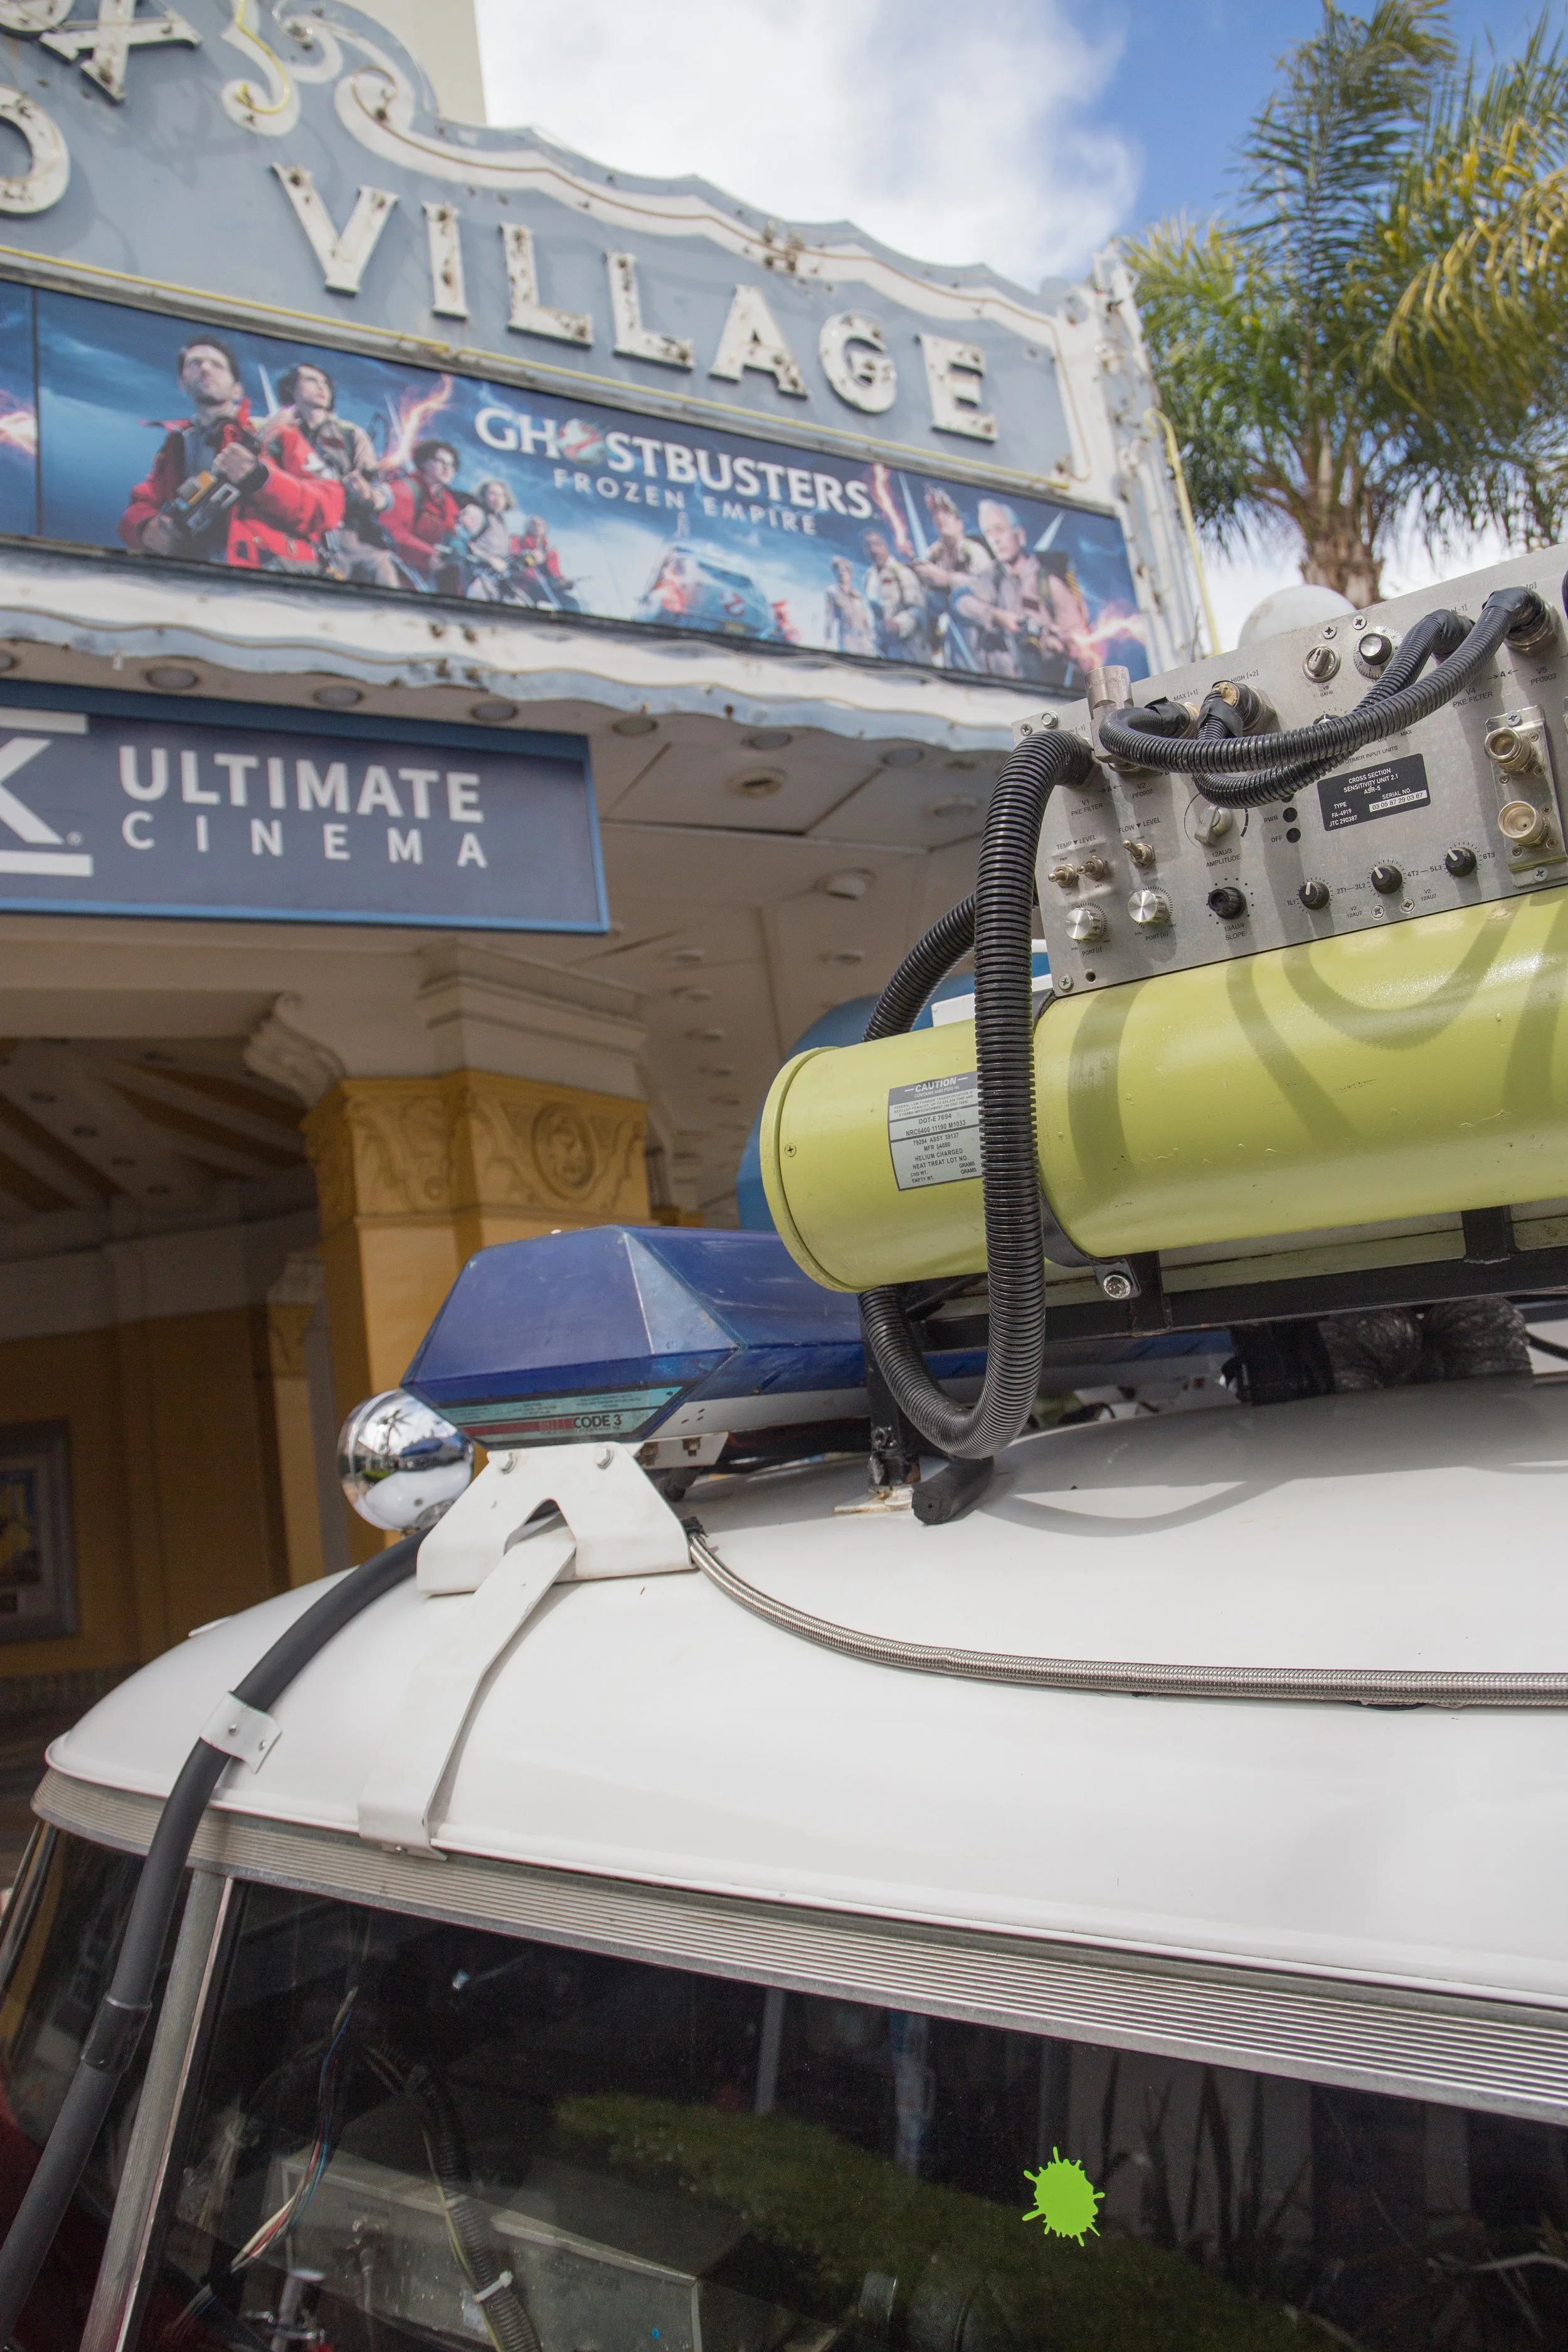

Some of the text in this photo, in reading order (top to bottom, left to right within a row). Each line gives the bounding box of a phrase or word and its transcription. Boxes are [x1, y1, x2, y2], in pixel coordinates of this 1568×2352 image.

[271, 163, 996, 442] VILLAGE
[553, 468, 817, 536] FROZEN EMPIRE
[1246, 669, 1259, 679] [+2]
[1536, 666, 1547, 675] V5
[1530, 673, 1557, 685] PF0903
[1465, 687, 1476, 695] V4
[1173, 694, 1187, 702] MAX
[1453, 691, 1493, 707] PKE FILTER
[1366, 750, 1381, 759] INPUT
[1382, 746, 1398, 754] UNITS
[1348, 768, 1391, 784] CROSS SECTION
[119, 745, 485, 824] ULTIMATE
[1343, 780, 1375, 793] SENSITIVITY
[1376, 775, 1390, 784] UNIT
[1132, 789, 1153, 799] PF0902
[1364, 786, 1381, 795] ASR-5
[1382, 791, 1401, 800] SERIAL
[1071, 803, 1103, 817] PKE FILTER
[1333, 801, 1347, 810] TYPE
[1331, 808, 1352, 818] FA-4919
[1118, 817, 1162, 834] FLOW LEVEL
[1264, 815, 1278, 824] PWR
[1329, 815, 1358, 827] JTC 290387
[122, 810, 487, 869] CINEMA
[1056, 835, 1097, 850] TEMP LEVEL
[1271, 835, 1283, 843] OFF
[1211, 848, 1232, 858] 12AU/3
[1205, 854, 1241, 868] AMPLITUDE
[1224, 923, 1245, 933] 13AU/4
[1145, 933, 1160, 941] PORT
[1225, 931, 1246, 941] SLOPE
[1082, 948, 1096, 956] PORT
[915, 1077, 956, 1093] CAUTION
[936, 1092, 969, 1101] TRANSPORTATION
[918, 1113, 952, 1125] DOT-E 7694
[906, 1120, 966, 1136] NRC6400 11190 M1033
[945, 1132, 959, 1140] 39137
[914, 1148, 963, 1162] HELIUM CHARGED
[912, 1162, 926, 1170] HEAT
[927, 1158, 945, 1167] TREAT
[946, 1157, 958, 1165] LOT
[958, 1161, 975, 1169] GRAMS
[573, 1413, 622, 1428] CODE 3
